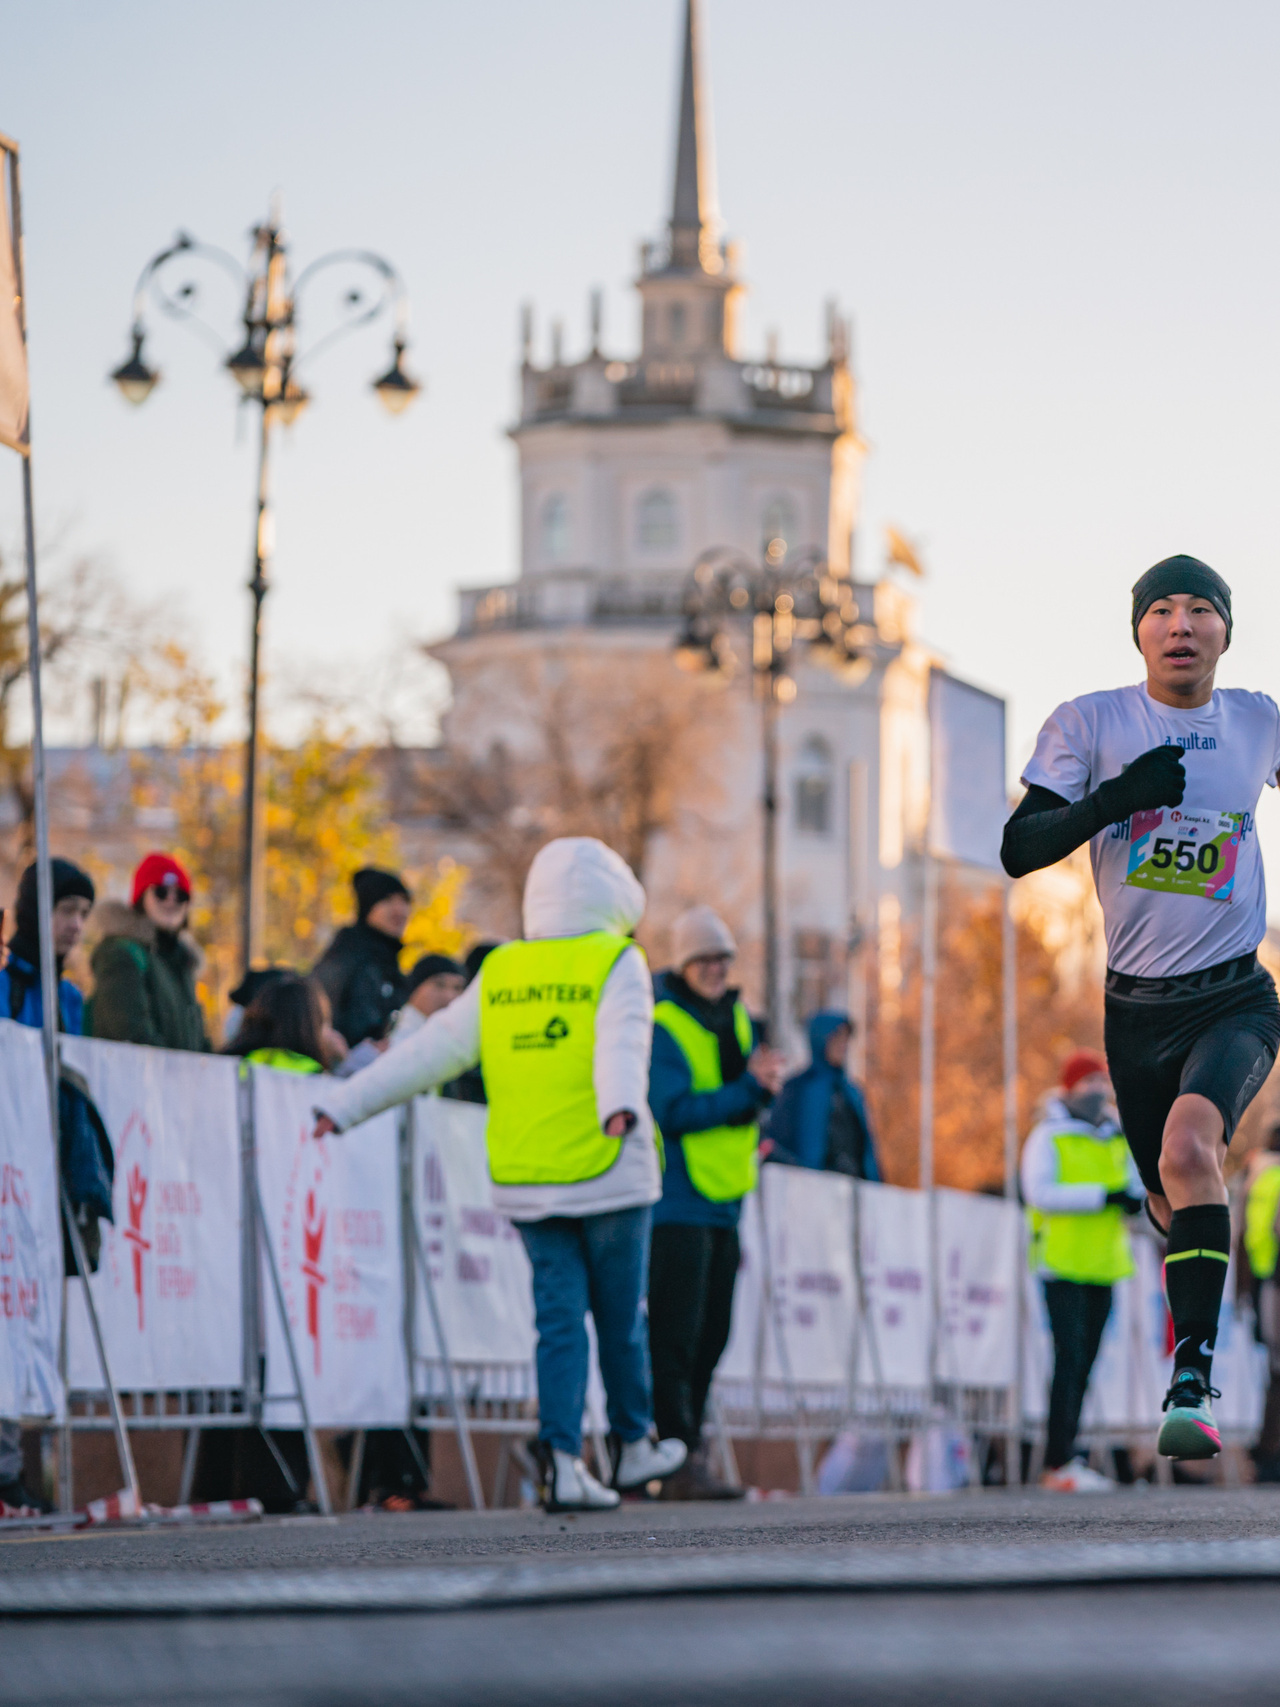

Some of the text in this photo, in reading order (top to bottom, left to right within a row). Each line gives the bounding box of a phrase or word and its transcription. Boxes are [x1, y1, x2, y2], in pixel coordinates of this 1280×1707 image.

[1184, 815, 1210, 824] Kaspi.kz
[1151, 838, 1219, 874] 550
[1130, 962, 1239, 996] 2XU
[488, 985, 593, 1006] VOLUNTEER
